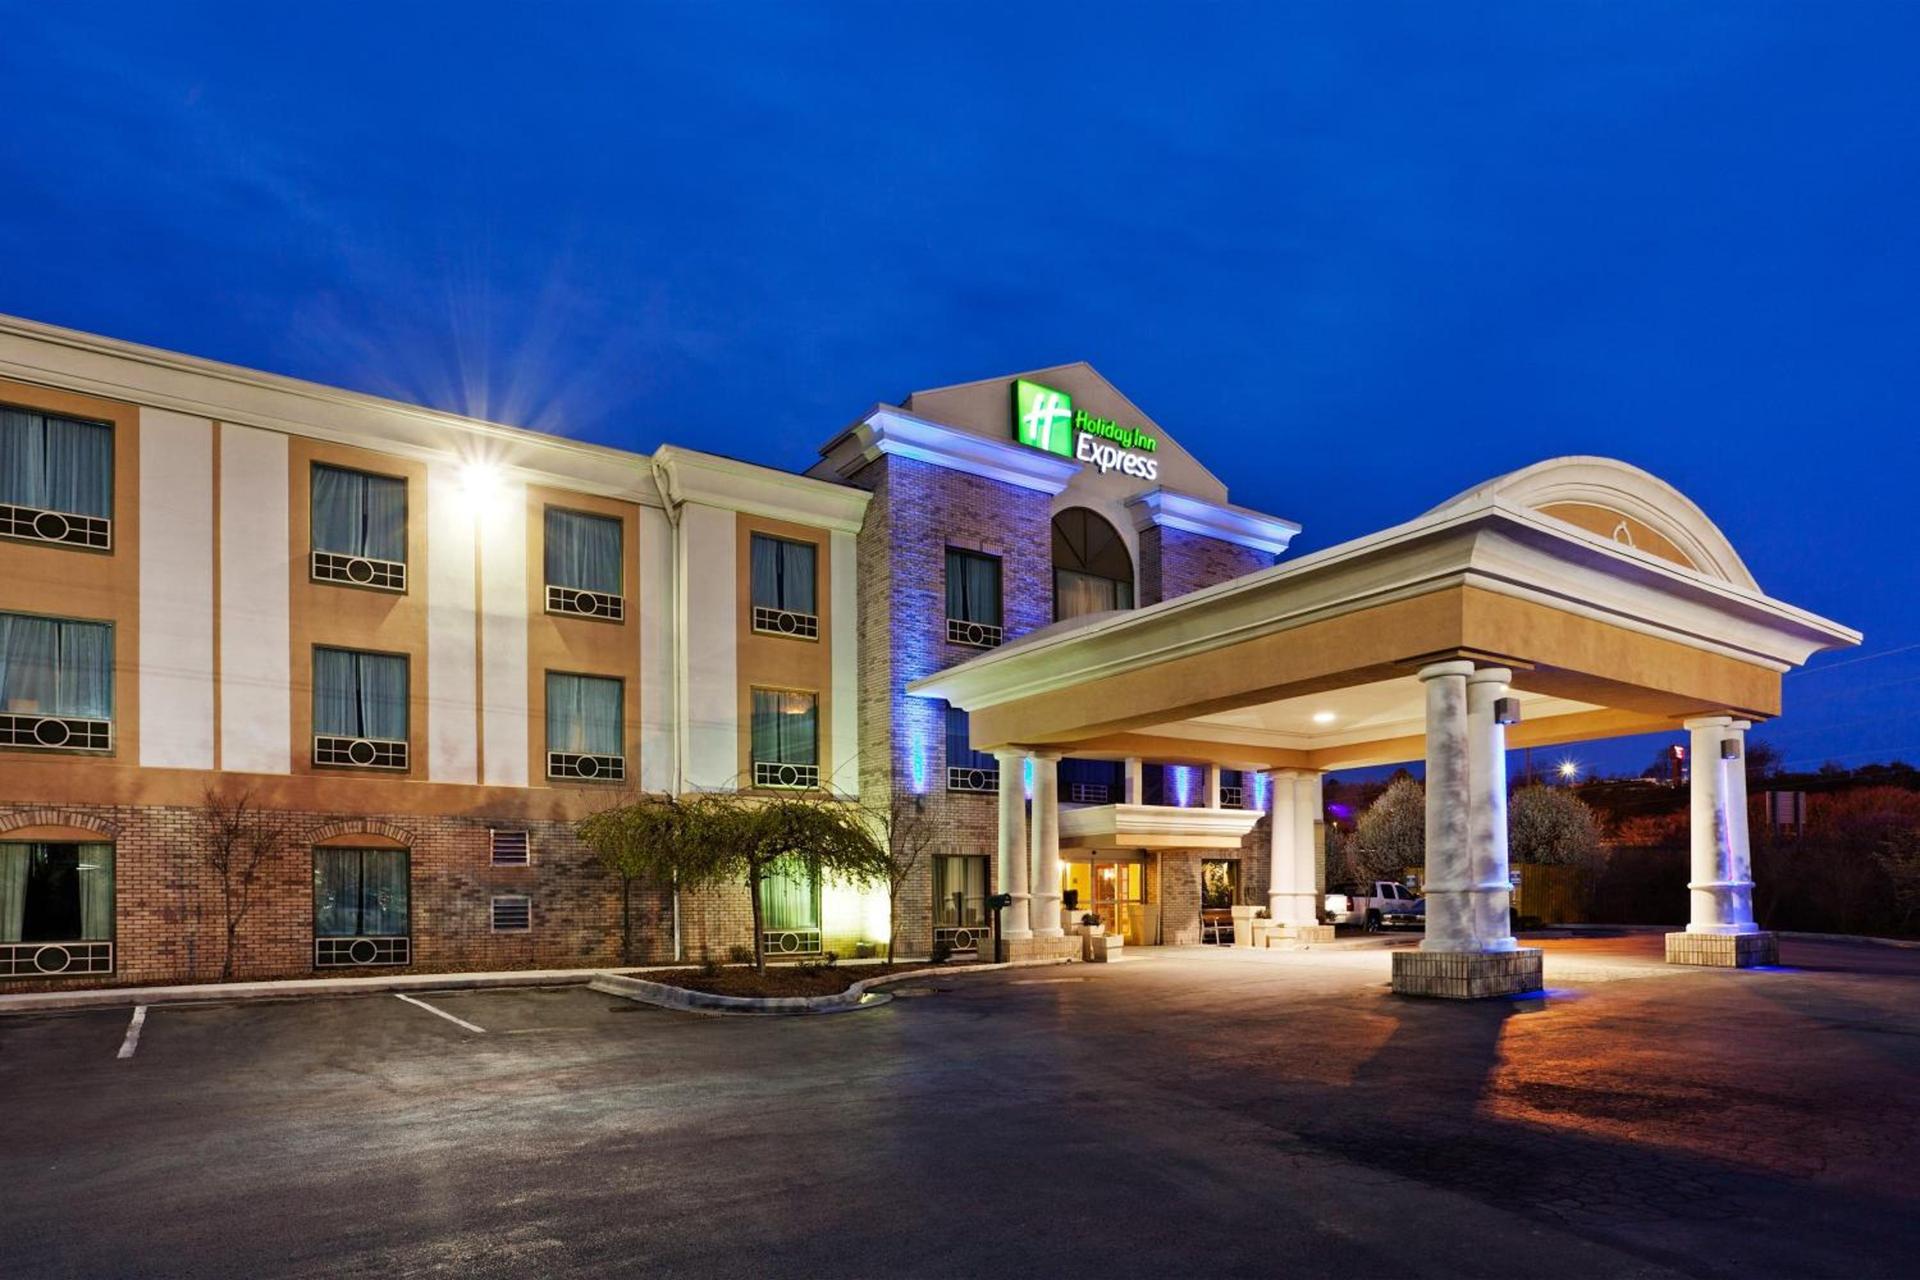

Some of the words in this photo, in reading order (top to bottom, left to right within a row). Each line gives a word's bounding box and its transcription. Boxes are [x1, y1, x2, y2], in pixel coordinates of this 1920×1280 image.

[1075, 410, 1133, 448] Holiday
[1134, 428, 1157, 452] Inn
[1076, 432, 1158, 480] Express
